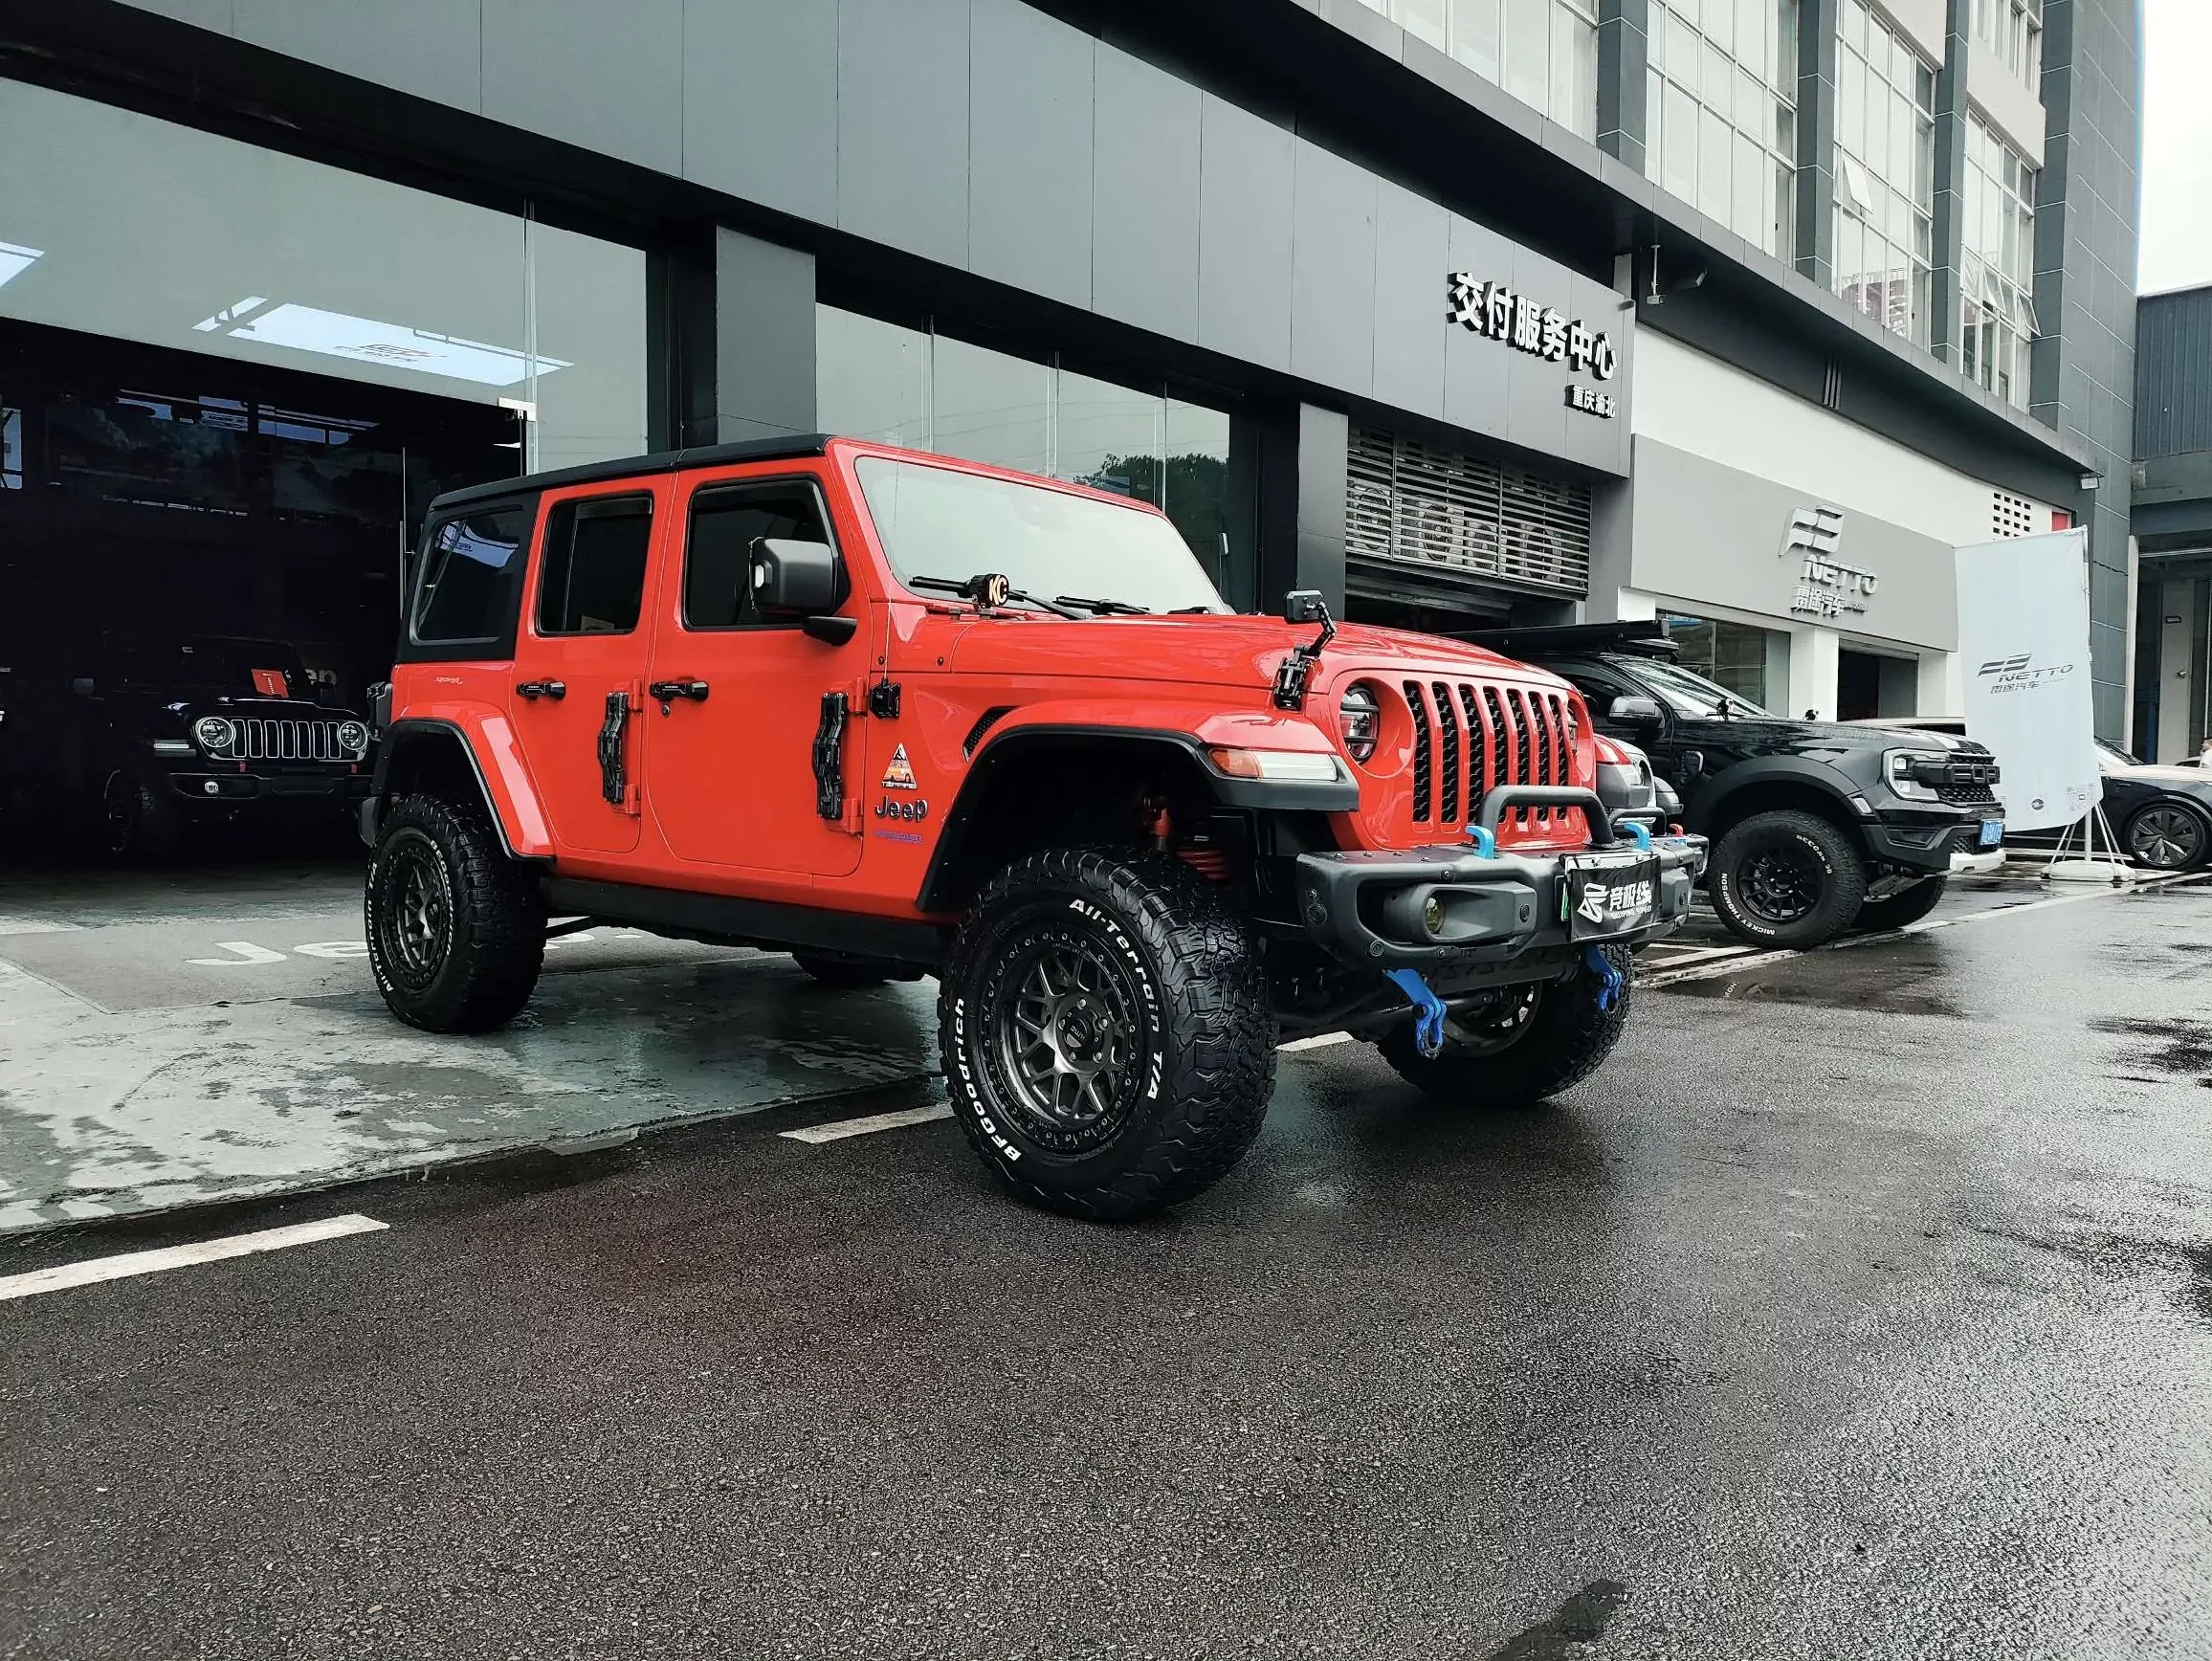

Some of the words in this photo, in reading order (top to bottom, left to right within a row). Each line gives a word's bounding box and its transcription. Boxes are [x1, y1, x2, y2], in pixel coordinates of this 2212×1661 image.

[1449, 272, 1617, 380] 交付服务中心
[1568, 385, 1615, 419] 重庆渝北
[989, 574, 1007, 605] KC
[1803, 555, 1879, 595] NETTO
[1998, 664, 2074, 682] NETTO
[874, 795, 928, 823] Jeep
[1720, 873, 1741, 920] THOMPSON
[1740, 919, 1777, 936] MICKEY
[1069, 898, 1160, 1033] All-Terrain
[1147, 1051, 1162, 1100] T/A
[954, 998, 1021, 1162] BFGoodrich
